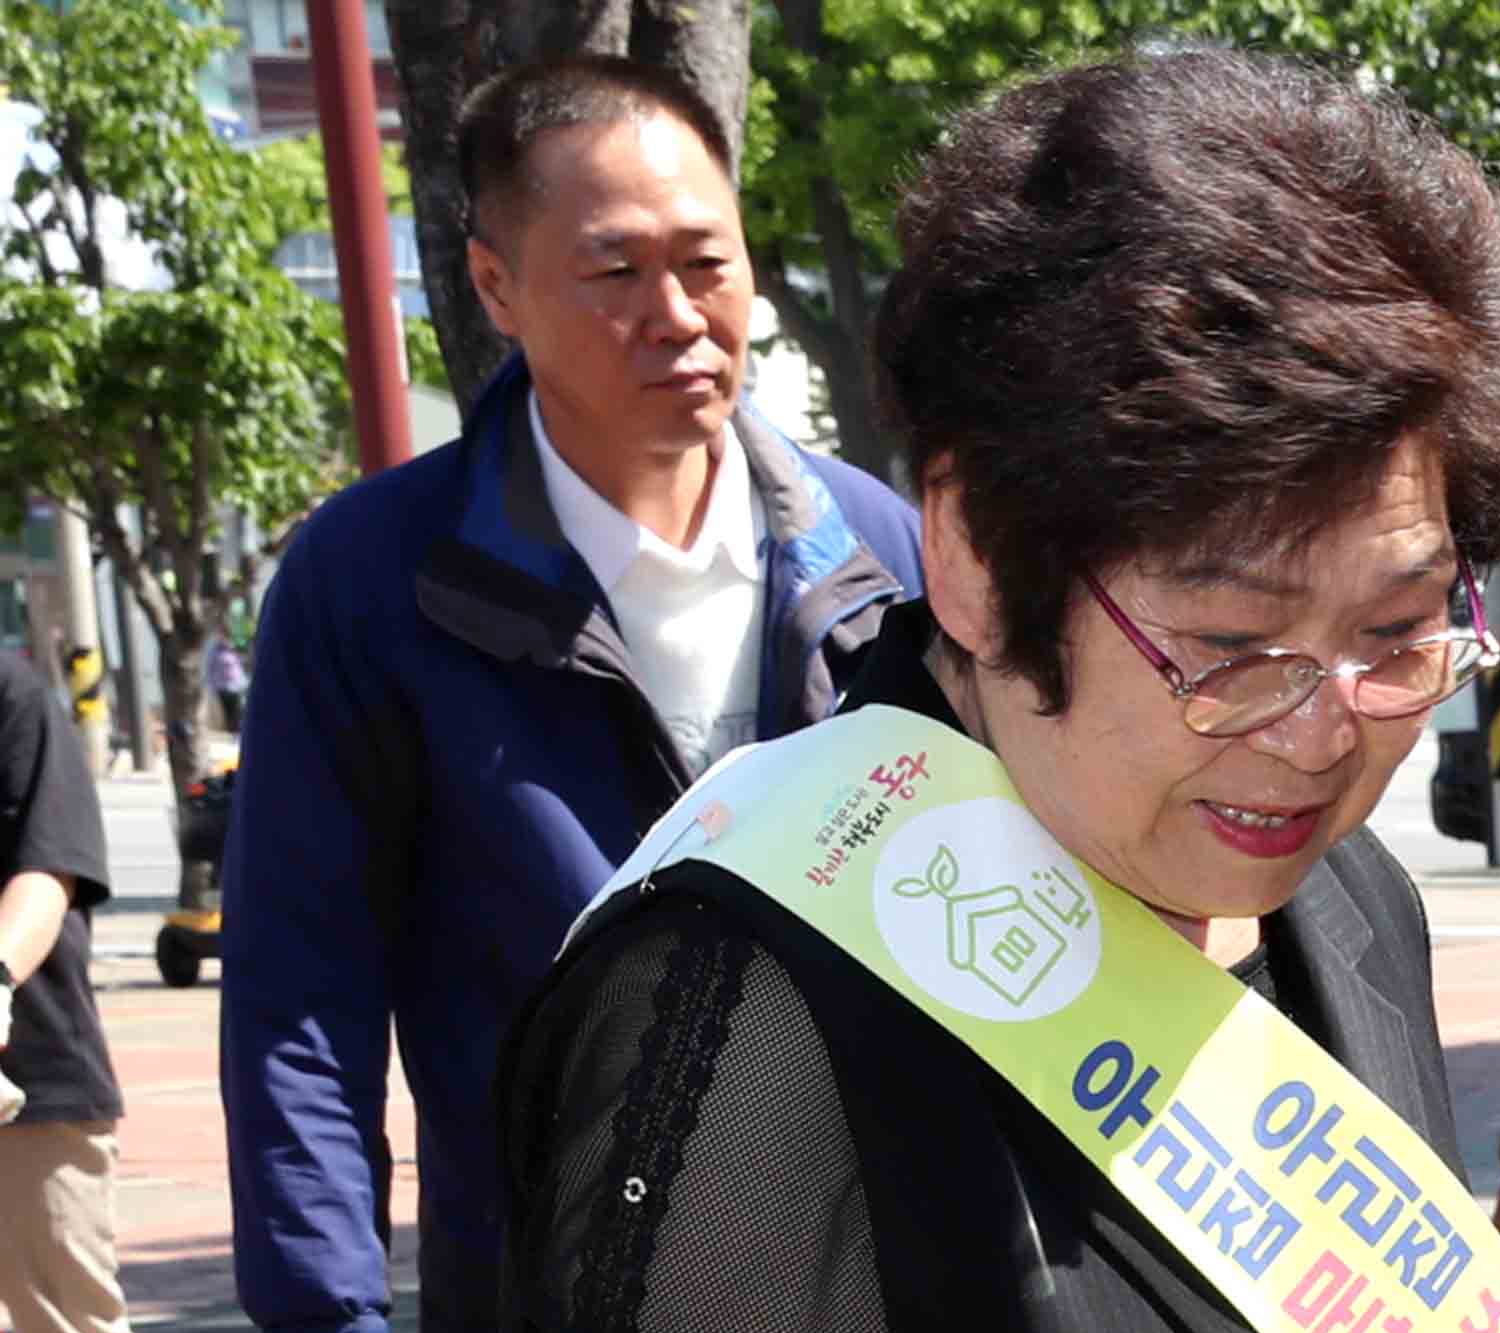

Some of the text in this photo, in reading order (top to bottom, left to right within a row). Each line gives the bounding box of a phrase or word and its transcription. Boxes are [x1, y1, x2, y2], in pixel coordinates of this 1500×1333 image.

[868, 751, 931, 800] 동구
[1072, 1040, 1301, 1281] 우리집
[1251, 1080, 1473, 1312] 우리집
